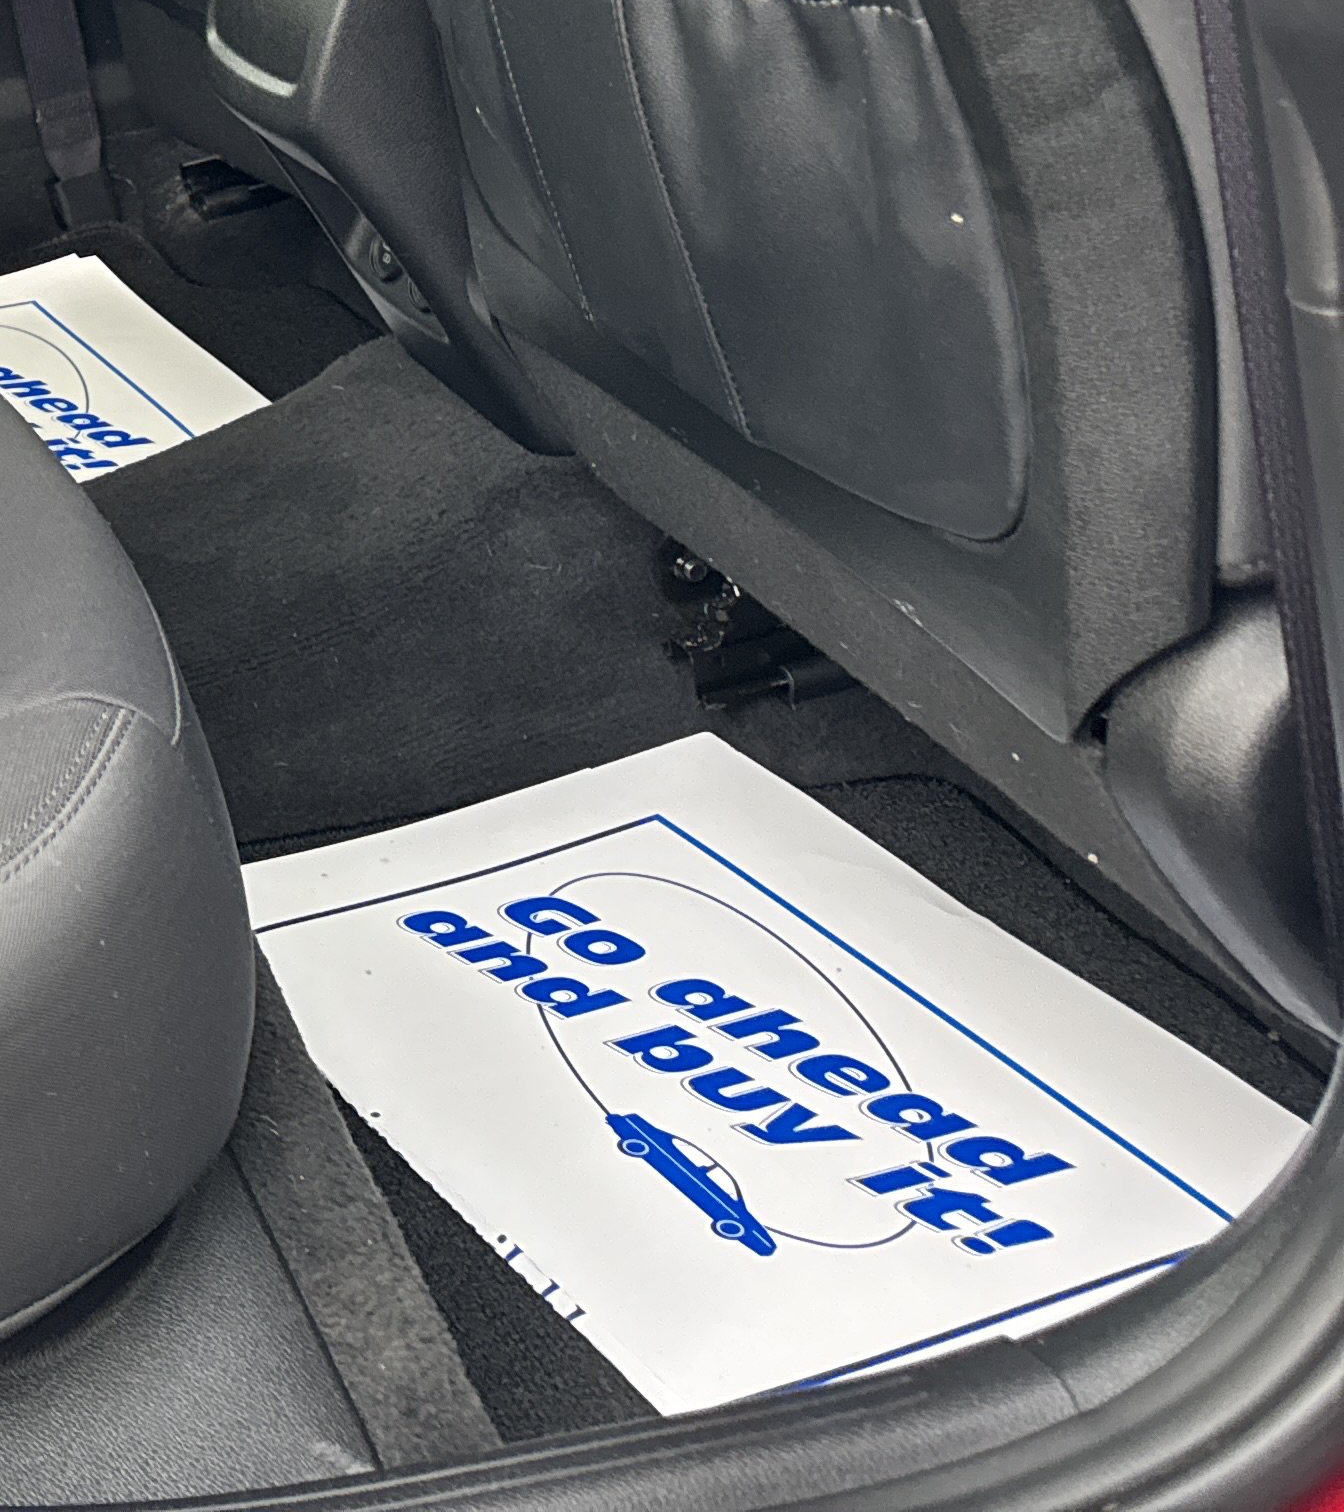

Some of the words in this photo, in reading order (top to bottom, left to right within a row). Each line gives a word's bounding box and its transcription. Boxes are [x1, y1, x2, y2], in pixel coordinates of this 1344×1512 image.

[397, 910, 631, 1019] and
[604, 1024, 860, 1146] buy
[848, 1162, 1055, 1256] it!
[497, 896, 646, 966] Go
[650, 978, 1076, 1188] ahead
